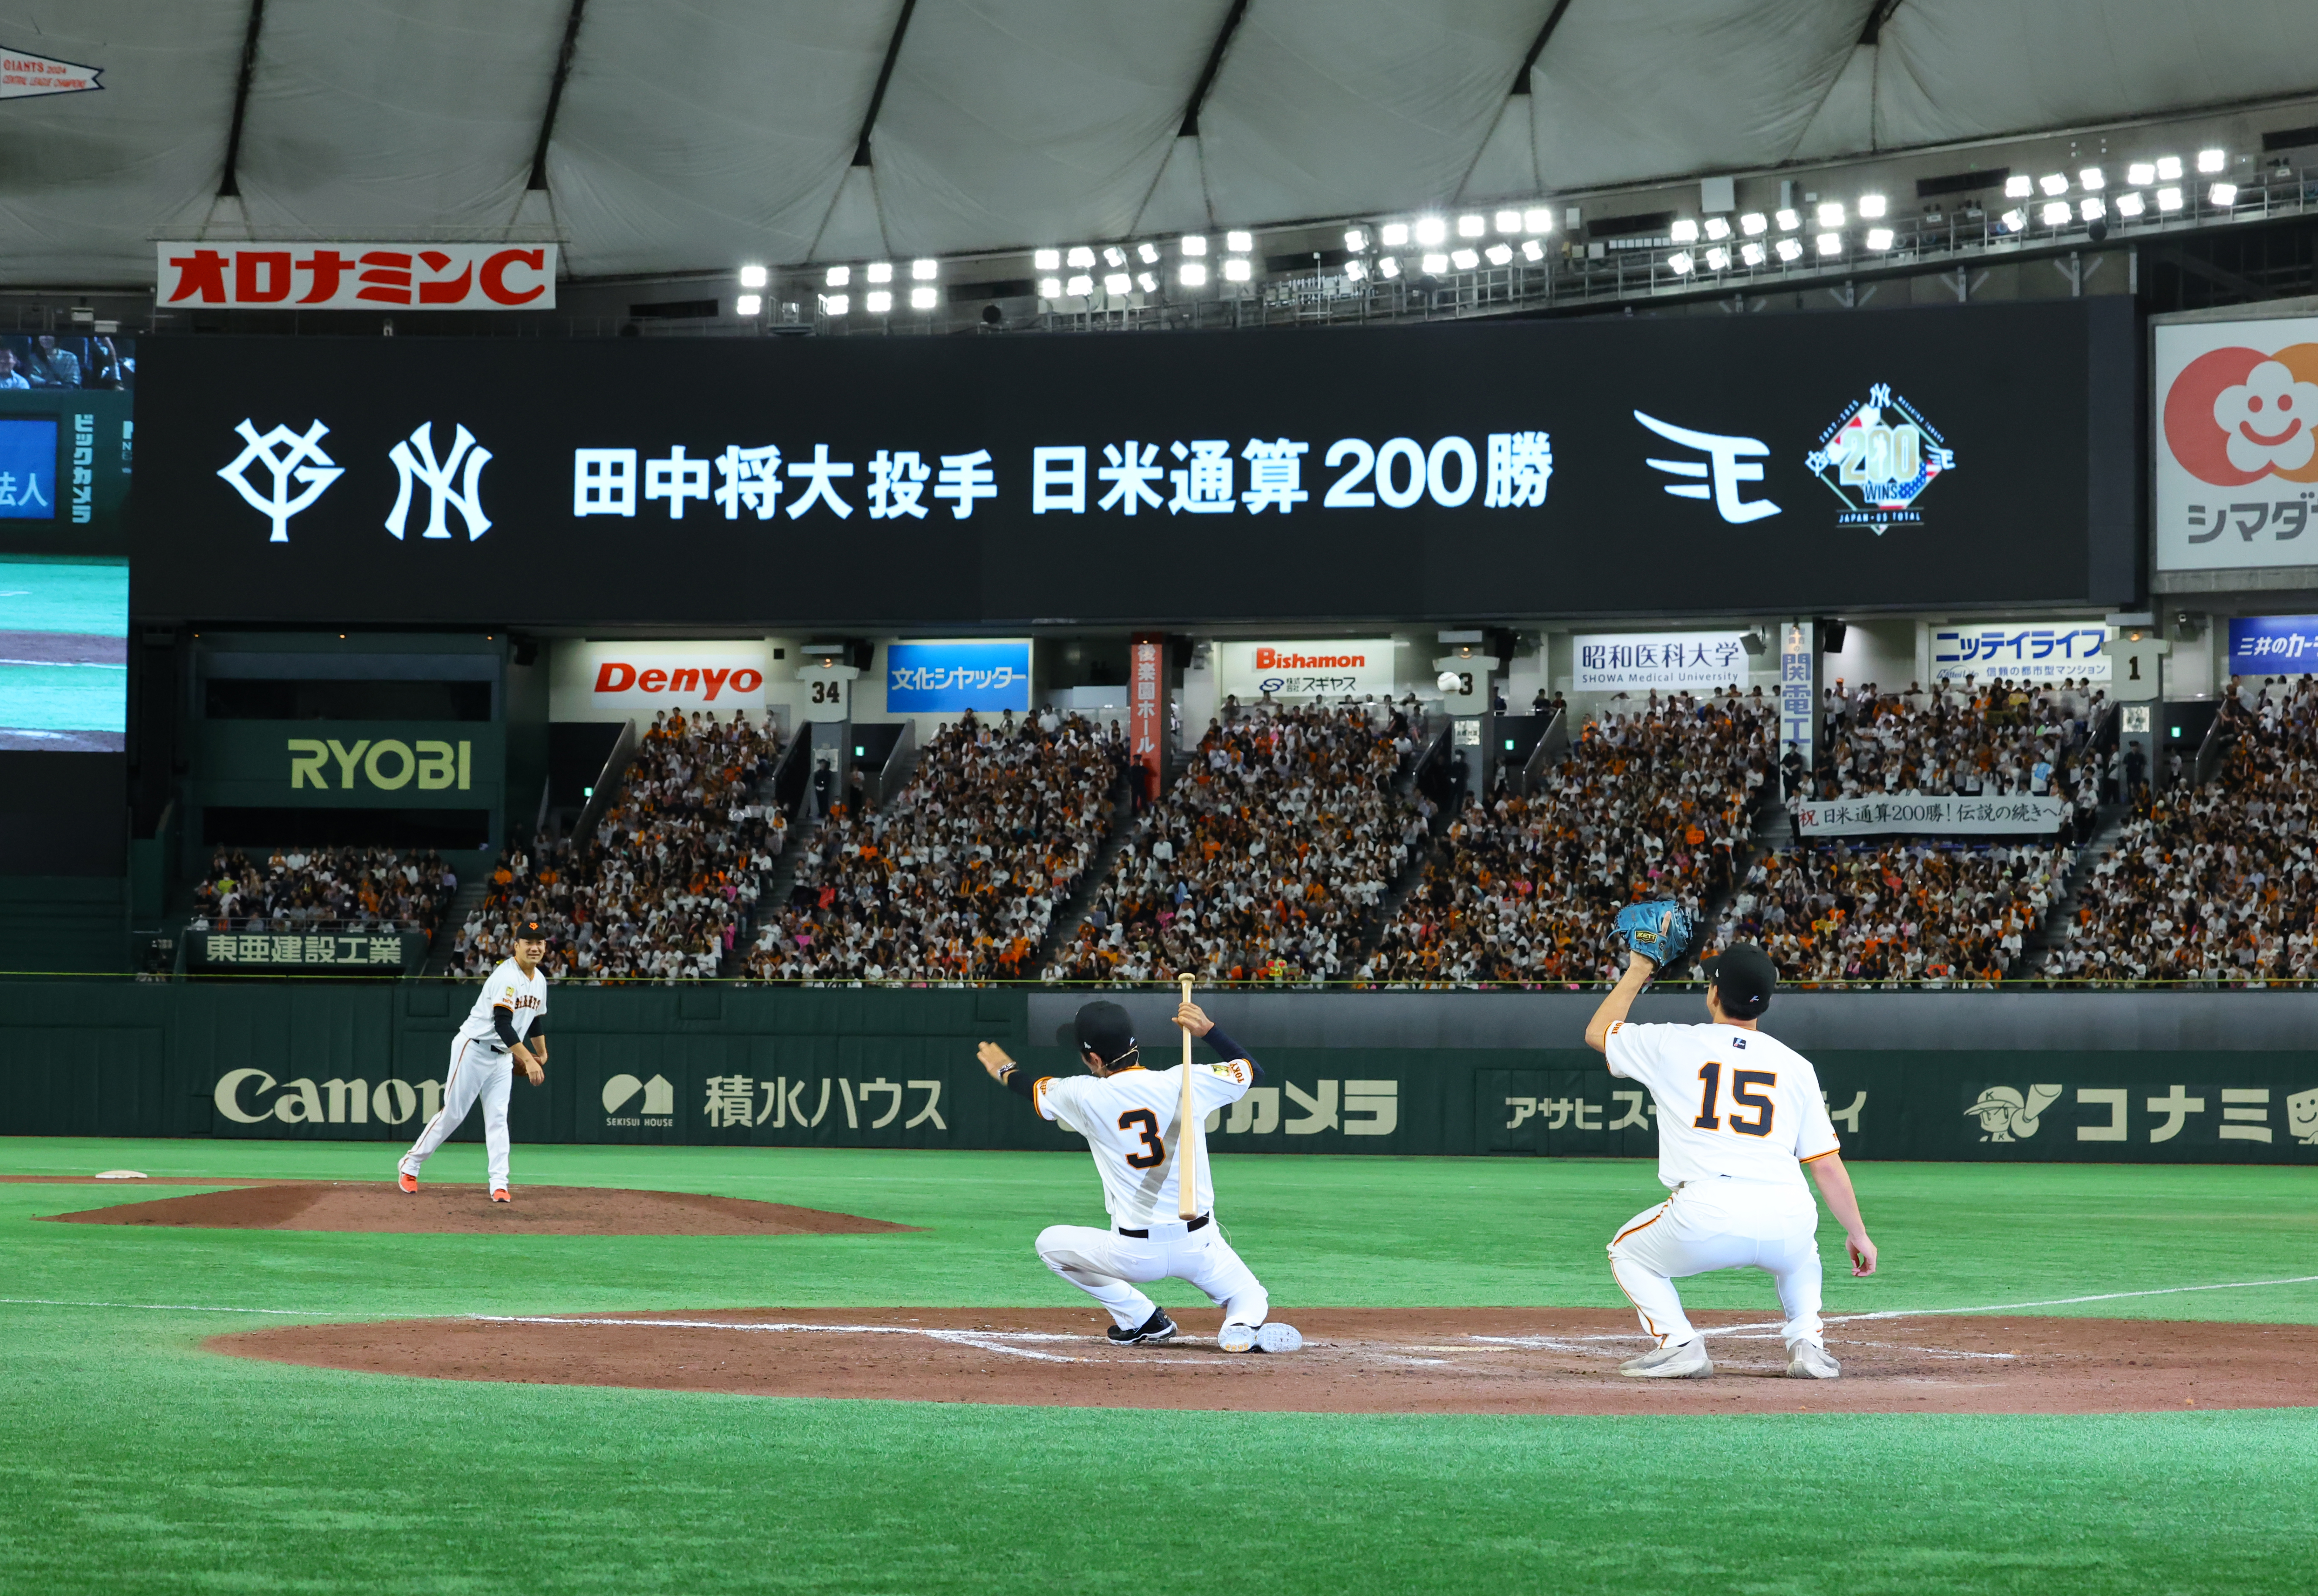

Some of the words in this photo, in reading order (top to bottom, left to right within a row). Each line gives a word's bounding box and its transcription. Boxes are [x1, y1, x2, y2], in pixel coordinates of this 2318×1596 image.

[3, 59, 44, 72] GIANTS
[168, 249, 546, 305] オロナミンC
[1839, 424, 1920, 486] 200
[573, 444, 997, 520] 田中将大投手
[1033, 431, 1553, 516] 日米通算200勝
[1865, 484, 1898, 501] WINS
[2188, 492, 2318, 544] シマダ
[1256, 647, 1365, 670] Bishamon
[1583, 641, 1739, 669] 昭和医科大学
[1936, 629, 2105, 662] ニッテイライフ
[594, 662, 763, 702] Denyo
[1302, 676, 1356, 692] スギヤス
[1459, 673, 1473, 696] 3
[1582, 674, 1624, 683] SHOWA
[1629, 672, 1673, 682] Medical
[1679, 671, 1738, 682] University
[1986, 665, 2105, 677] 信頼の都市型マンション
[2129, 656, 2141, 680] 1
[812, 680, 840, 704] 34
[1136, 644, 1156, 754] 後楽園ホール
[1782, 653, 1812, 744] 関電工
[288, 739, 471, 790] RYOBI
[1799, 808, 1819, 828] 祝
[207, 934, 401, 964] 東亜建設工業
[704, 1074, 947, 1130] 積水ハウス
[1205, 1079, 1398, 1136] カメラ
[1505, 1090, 1658, 1132] アサヒス
[1693, 1060, 1778, 1138] 15
[2077, 1085, 2273, 1143] コナミ
[606, 1117, 640, 1127] SEKISUI
[644, 1118, 673, 1127] HOUSE
[1117, 1107, 1166, 1170] 3
